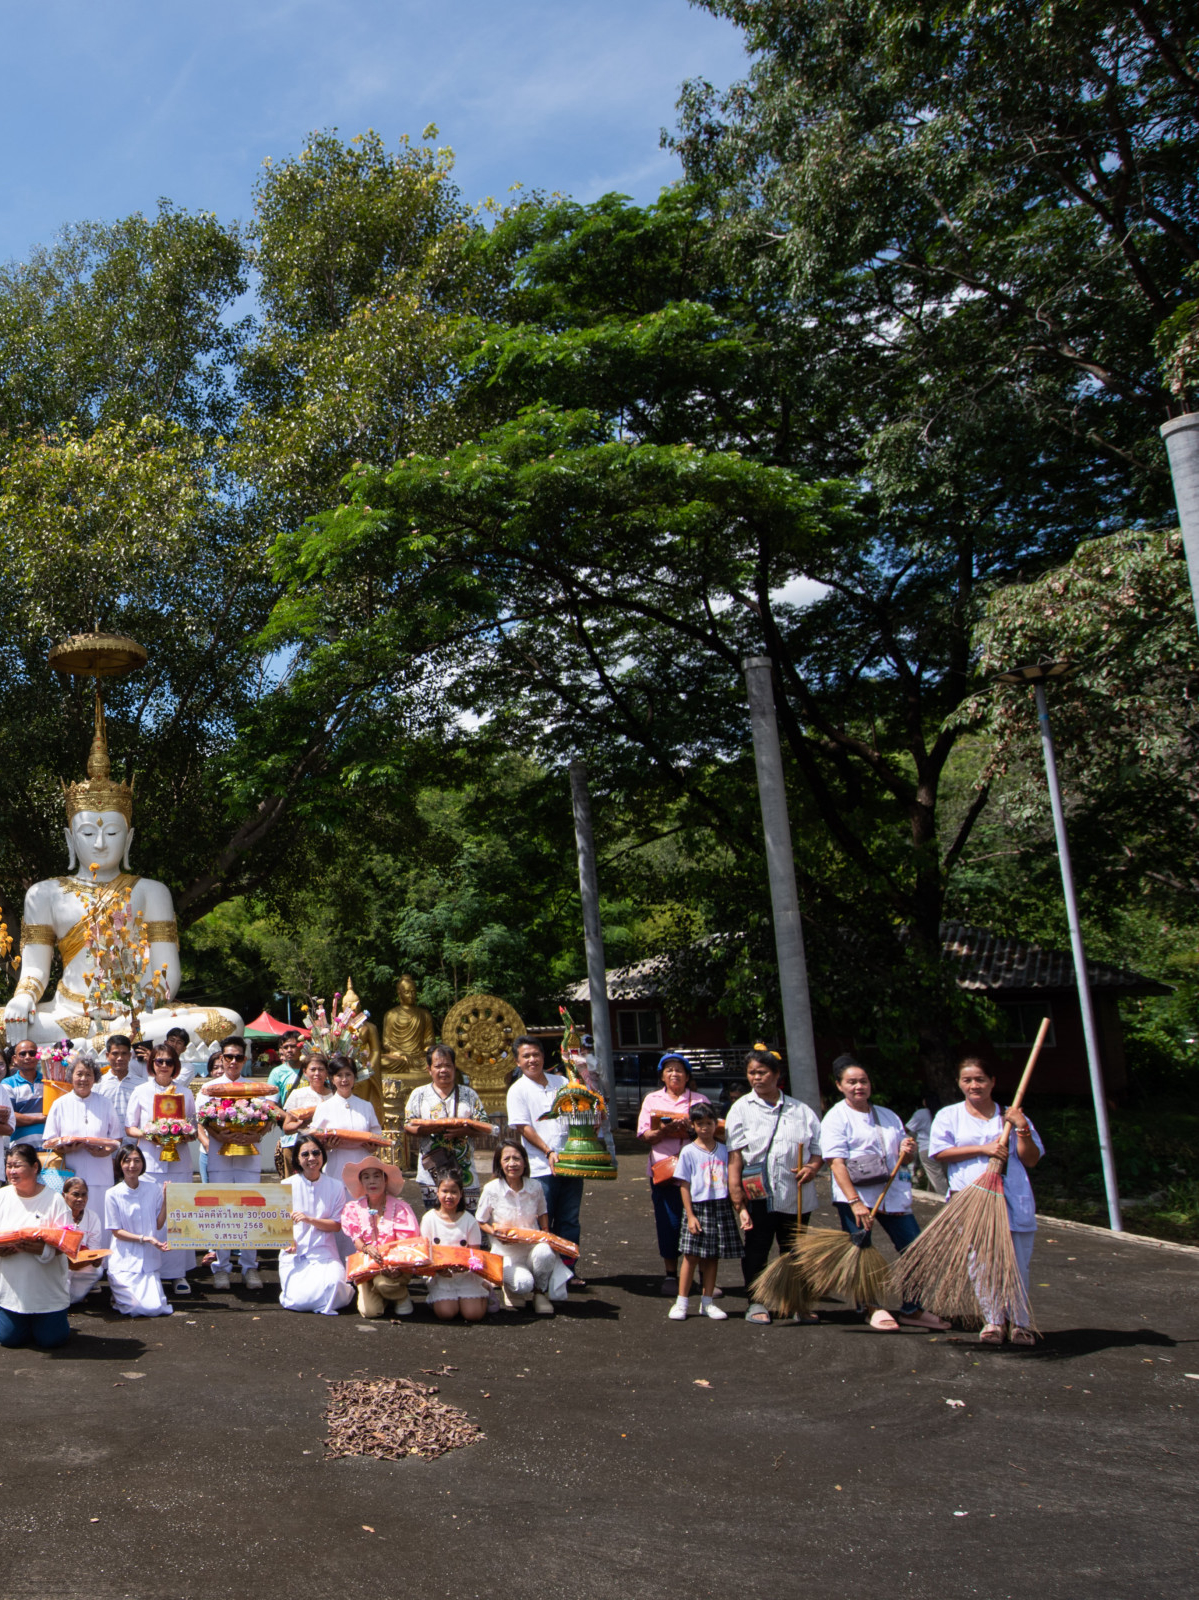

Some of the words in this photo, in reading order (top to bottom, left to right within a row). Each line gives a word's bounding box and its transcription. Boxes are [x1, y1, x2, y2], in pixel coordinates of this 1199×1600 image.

[170, 1209, 244, 1221] กฐินสามัคคีทั่วไทย
[247, 1211, 277, 1219] 30,000
[280, 1210, 291, 1219] วัด
[198, 1221, 241, 1231] พุทธศักราช
[214, 1231, 248, 1241] จ.สระบุรี
